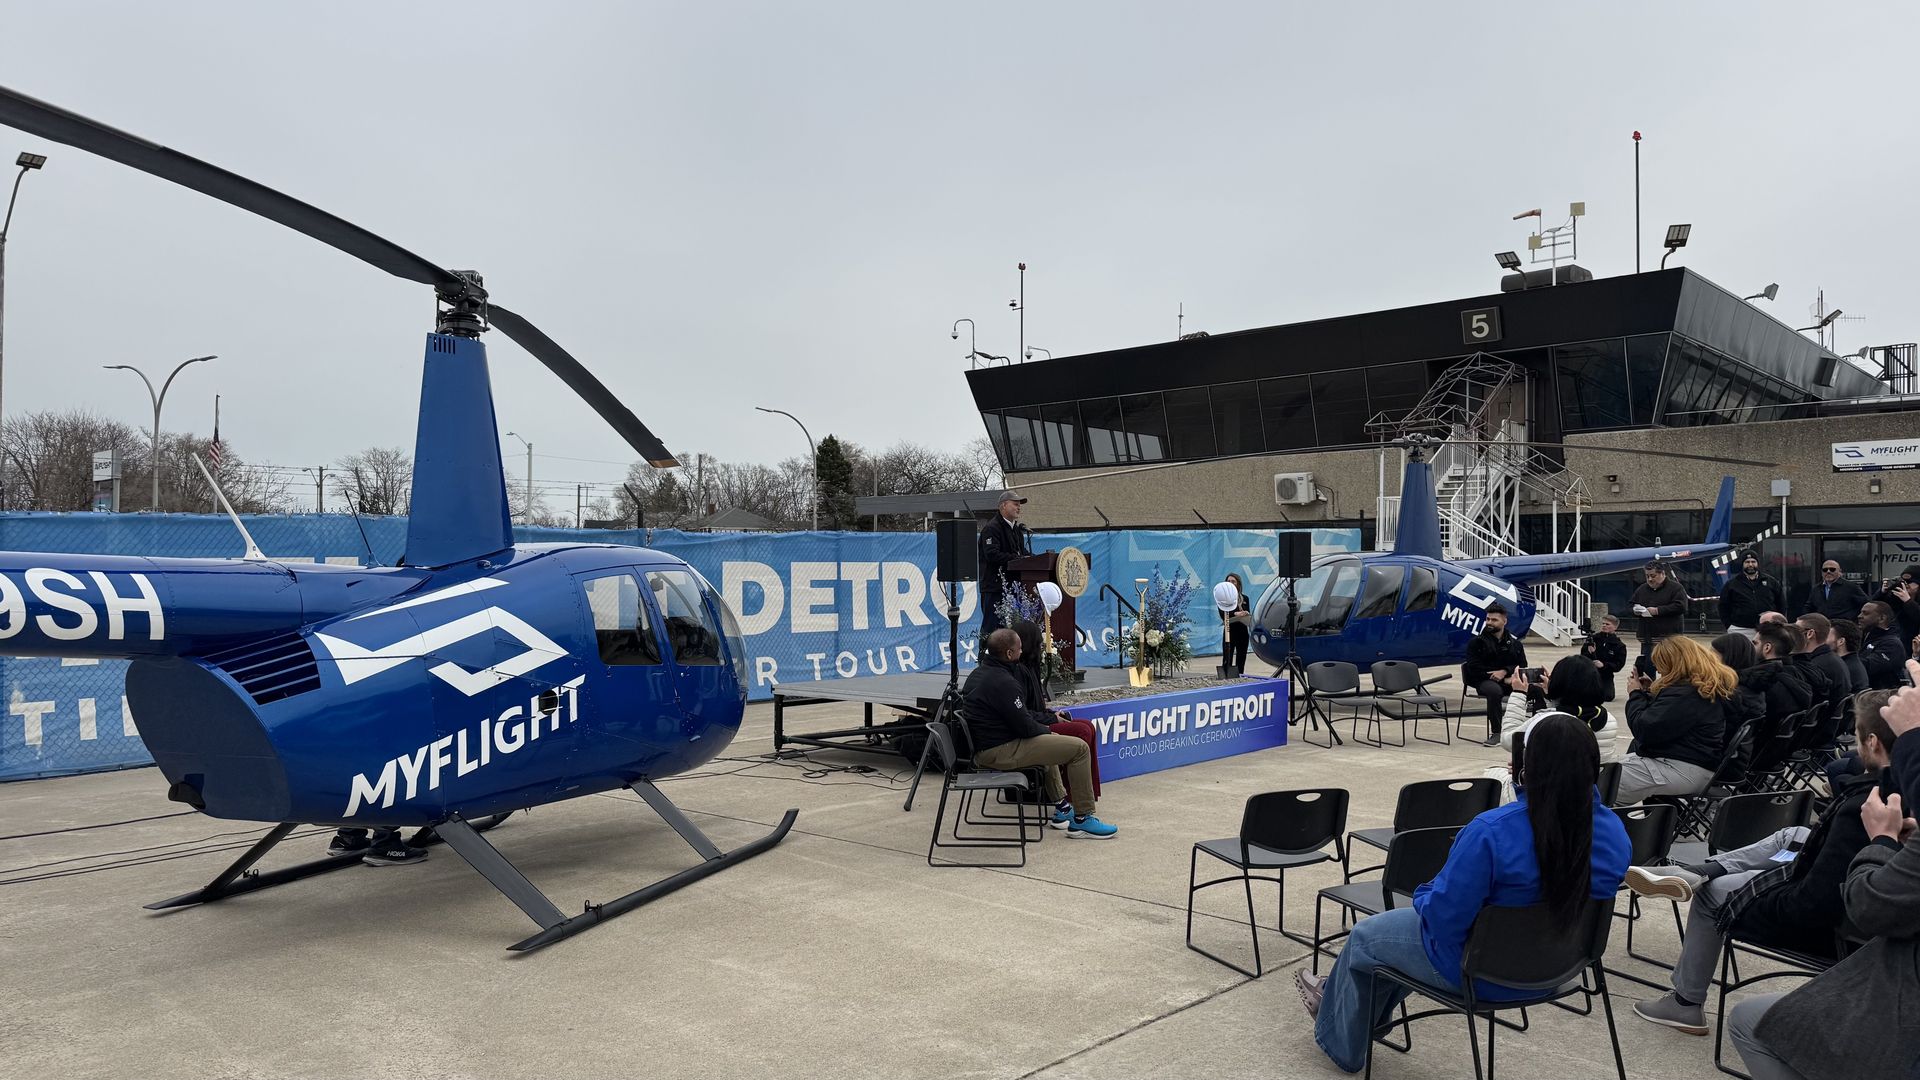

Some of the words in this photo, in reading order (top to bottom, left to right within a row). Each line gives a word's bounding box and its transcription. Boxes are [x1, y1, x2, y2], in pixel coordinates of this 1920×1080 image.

[1472, 314, 1489, 338] 5
[1871, 445, 1918, 454] MYFLIGHT
[1873, 553, 1920, 563] MYFLIG
[722, 561, 978, 637] DETRO
[806, 645, 919, 681] TOUR
[1091, 704, 1190, 745] YFLIGHT
[1195, 692, 1274, 729] DETROIT
[342, 674, 586, 818] MYFLIGHT
[1118, 741, 1157, 760] GROUND
[1159, 734, 1200, 752] BREAKING
[1201, 727, 1242, 744] CEREMONY
